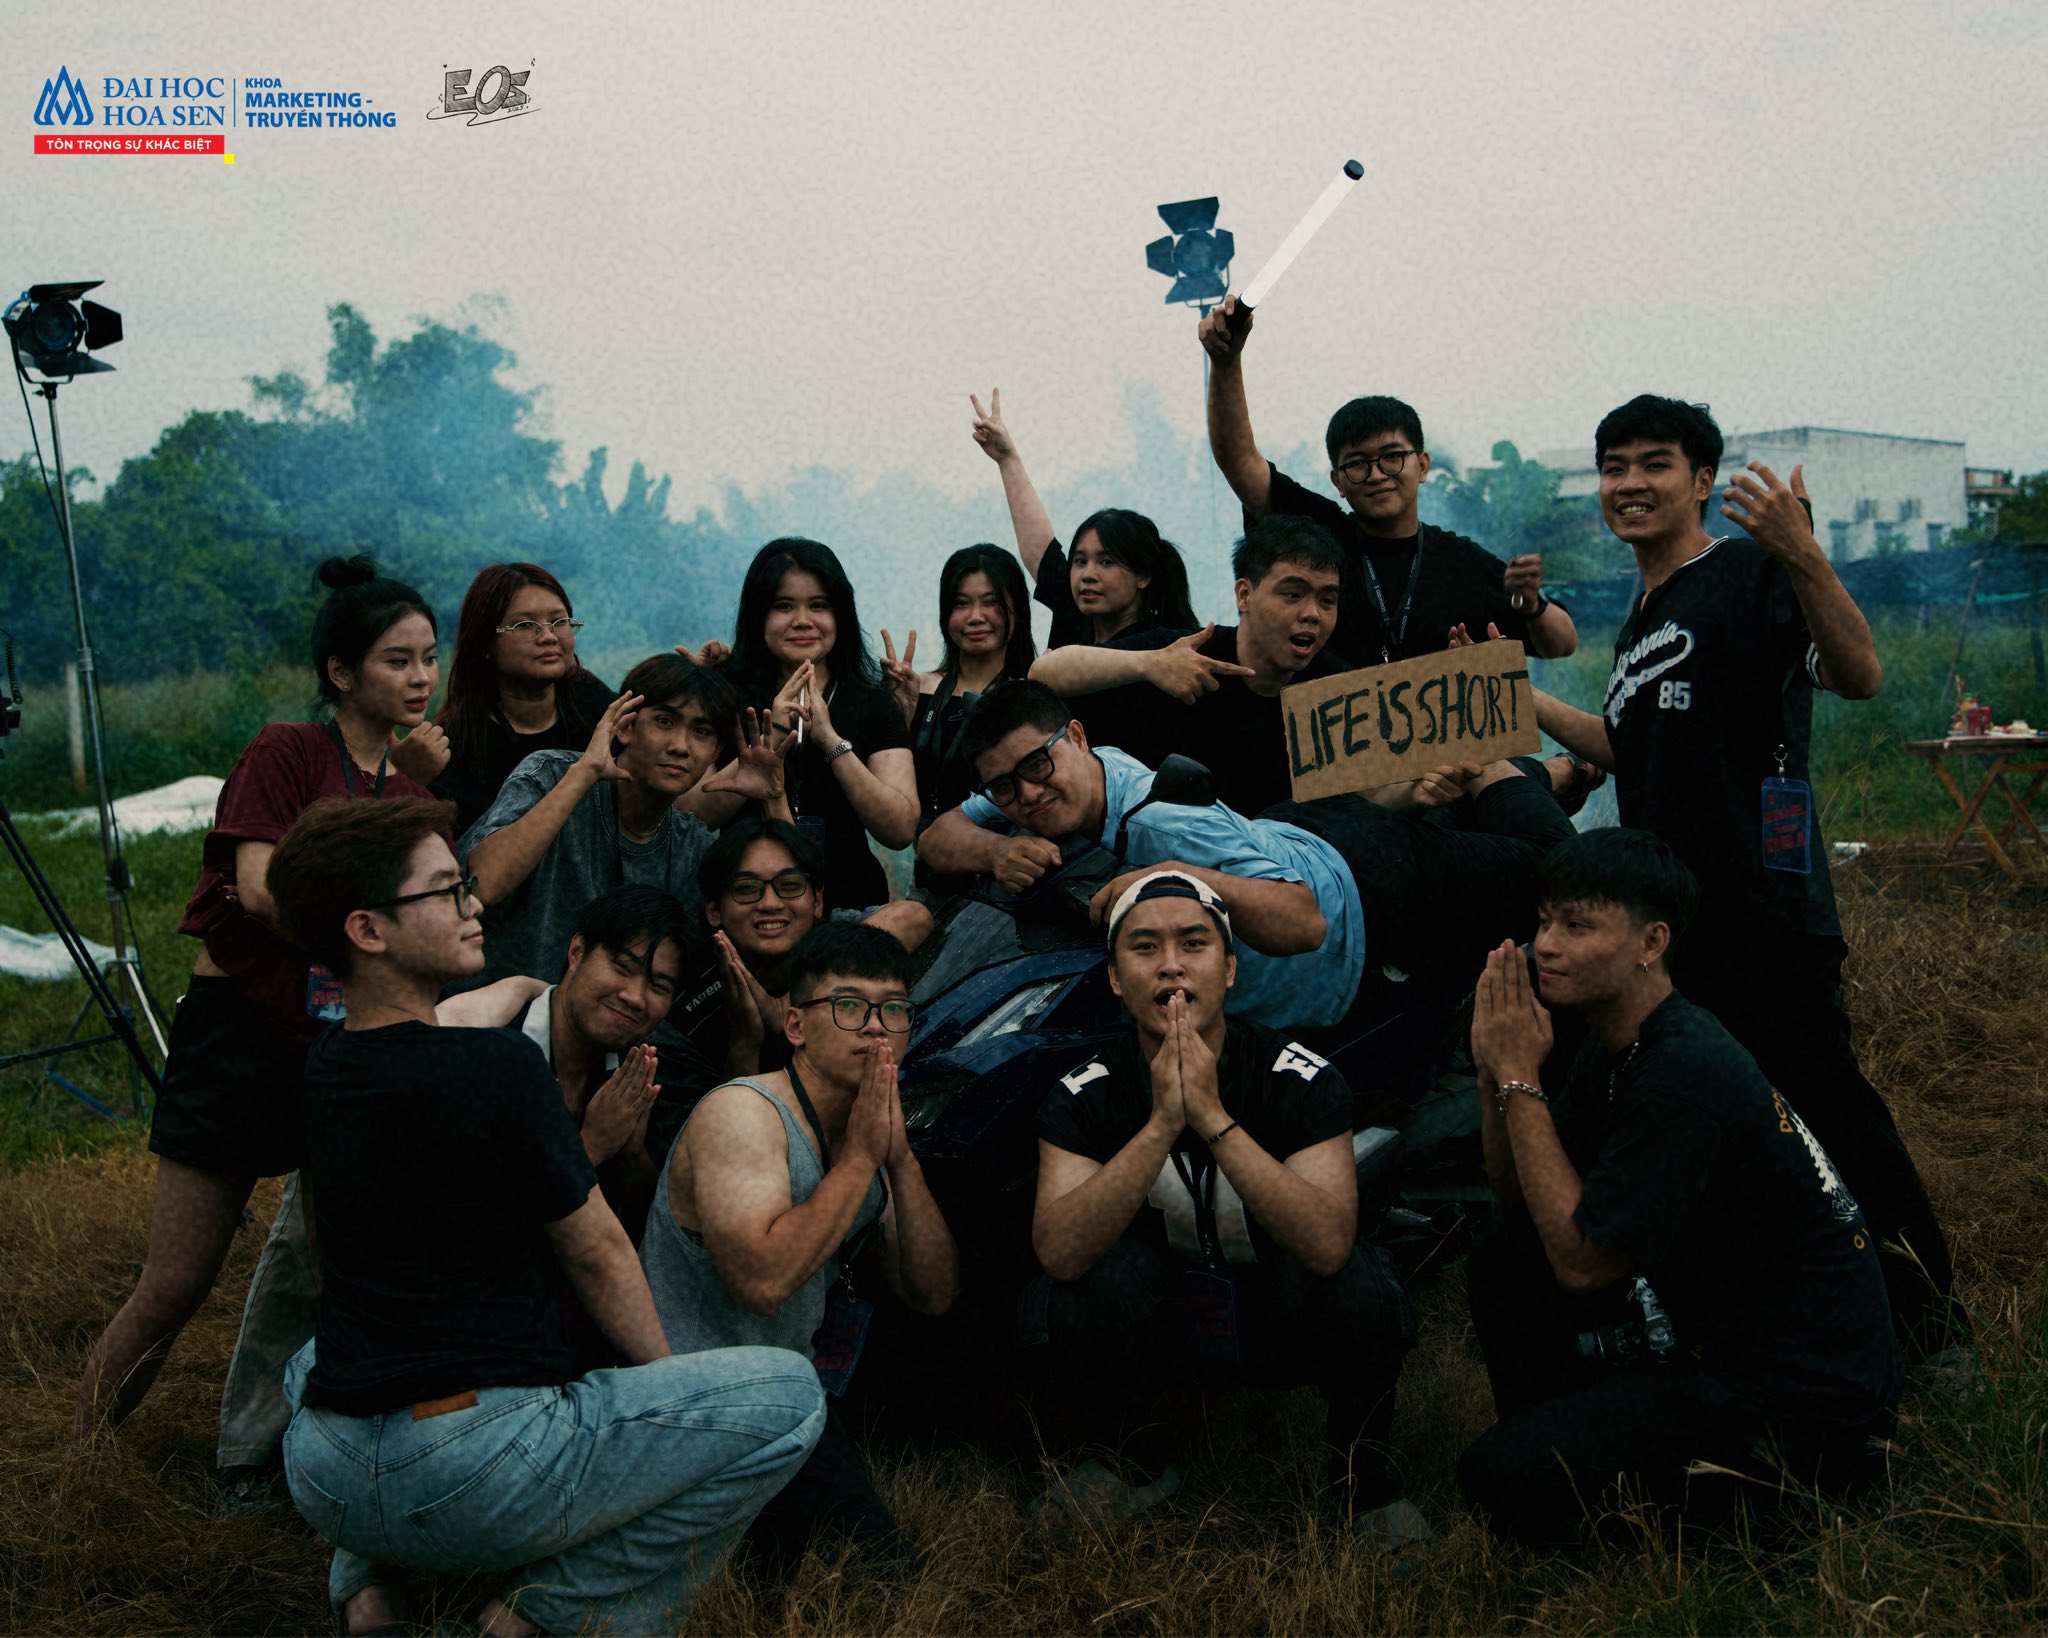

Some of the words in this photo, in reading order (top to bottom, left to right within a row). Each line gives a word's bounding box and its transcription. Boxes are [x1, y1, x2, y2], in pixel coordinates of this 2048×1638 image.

[1288, 688, 1371, 777] LIFE
[1416, 670, 1528, 744] SHORT
[1658, 679, 1692, 711] 85
